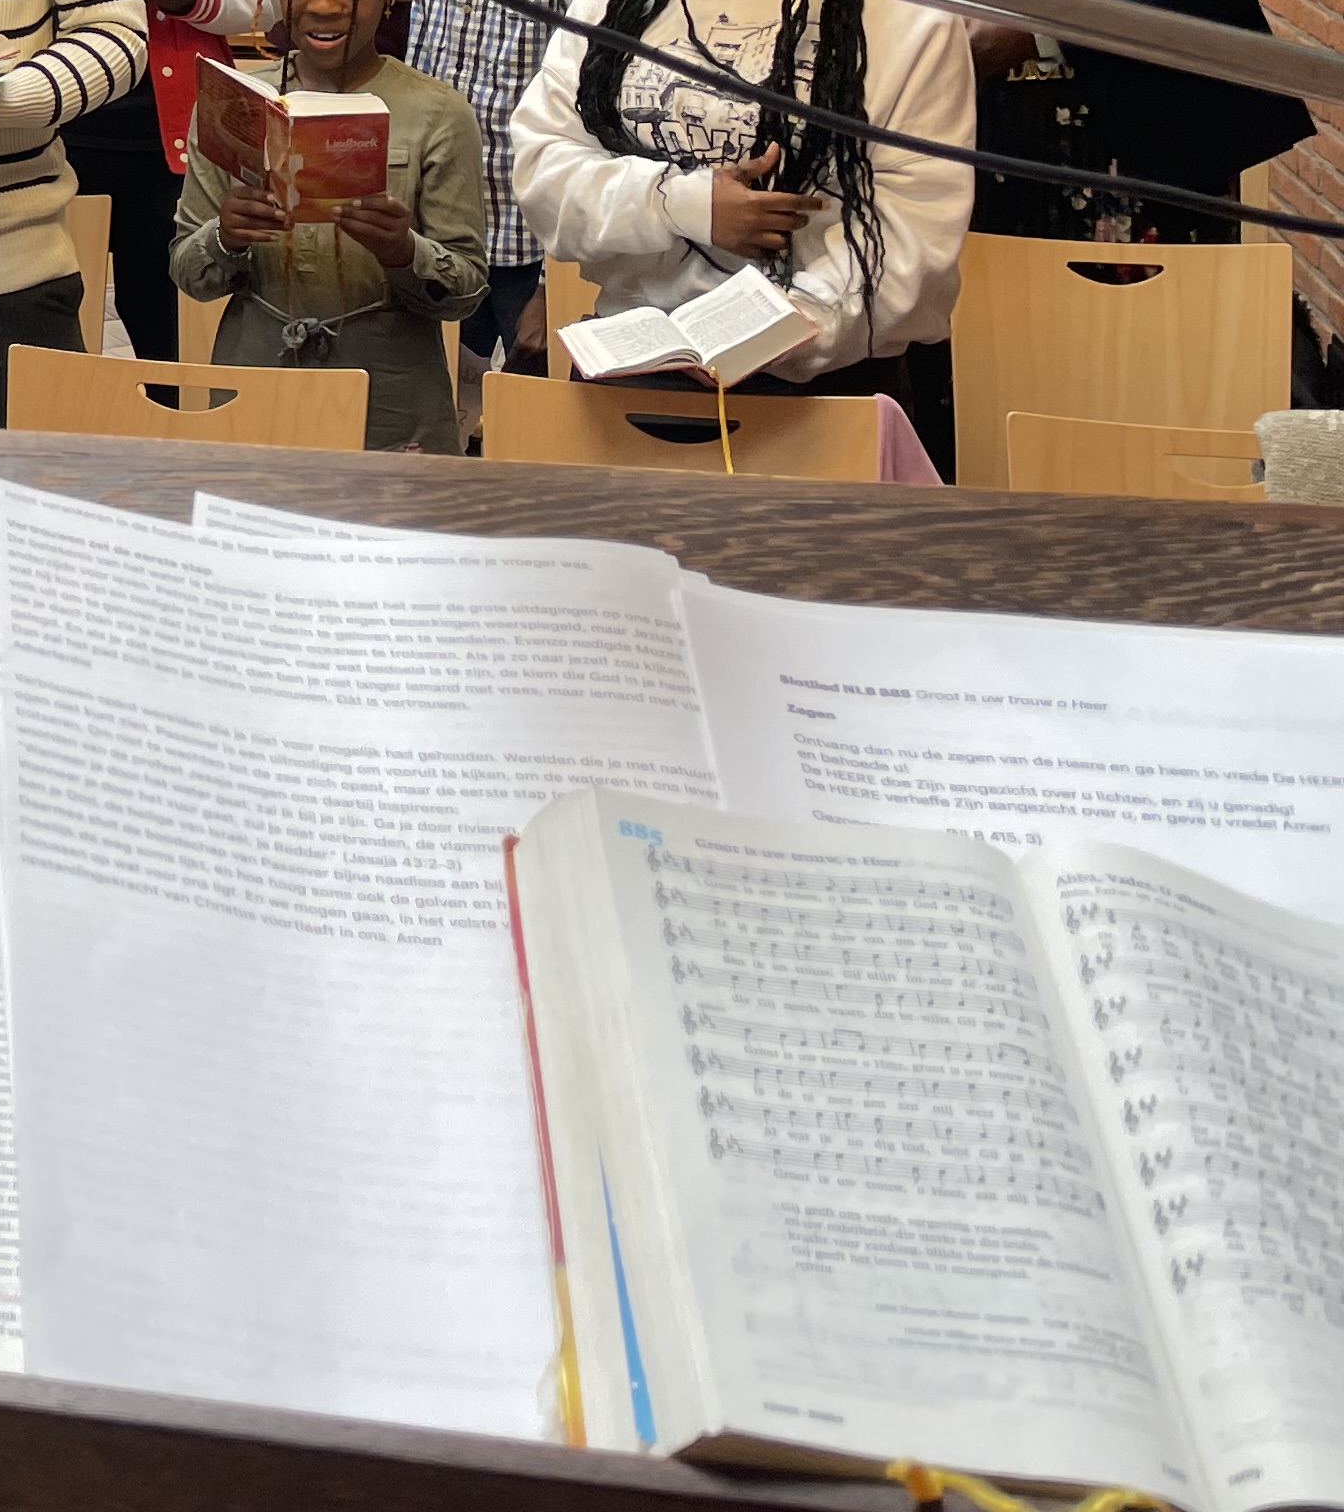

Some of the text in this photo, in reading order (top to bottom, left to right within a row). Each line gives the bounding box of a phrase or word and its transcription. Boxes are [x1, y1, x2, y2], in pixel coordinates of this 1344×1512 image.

[779, 674, 840, 692] Slotlied
[843, 683, 876, 697] NLB
[916, 689, 959, 701] Groot
[963, 691, 976, 703] is
[981, 694, 1004, 704] uw
[1008, 695, 1053, 707] trouw
[1056, 699, 1067, 708] o
[1072, 698, 1108, 711] Heer
[787, 703, 836, 720] Zegen
[1298, 774, 1344, 787] HEER
[618, 819, 663, 847] 885
